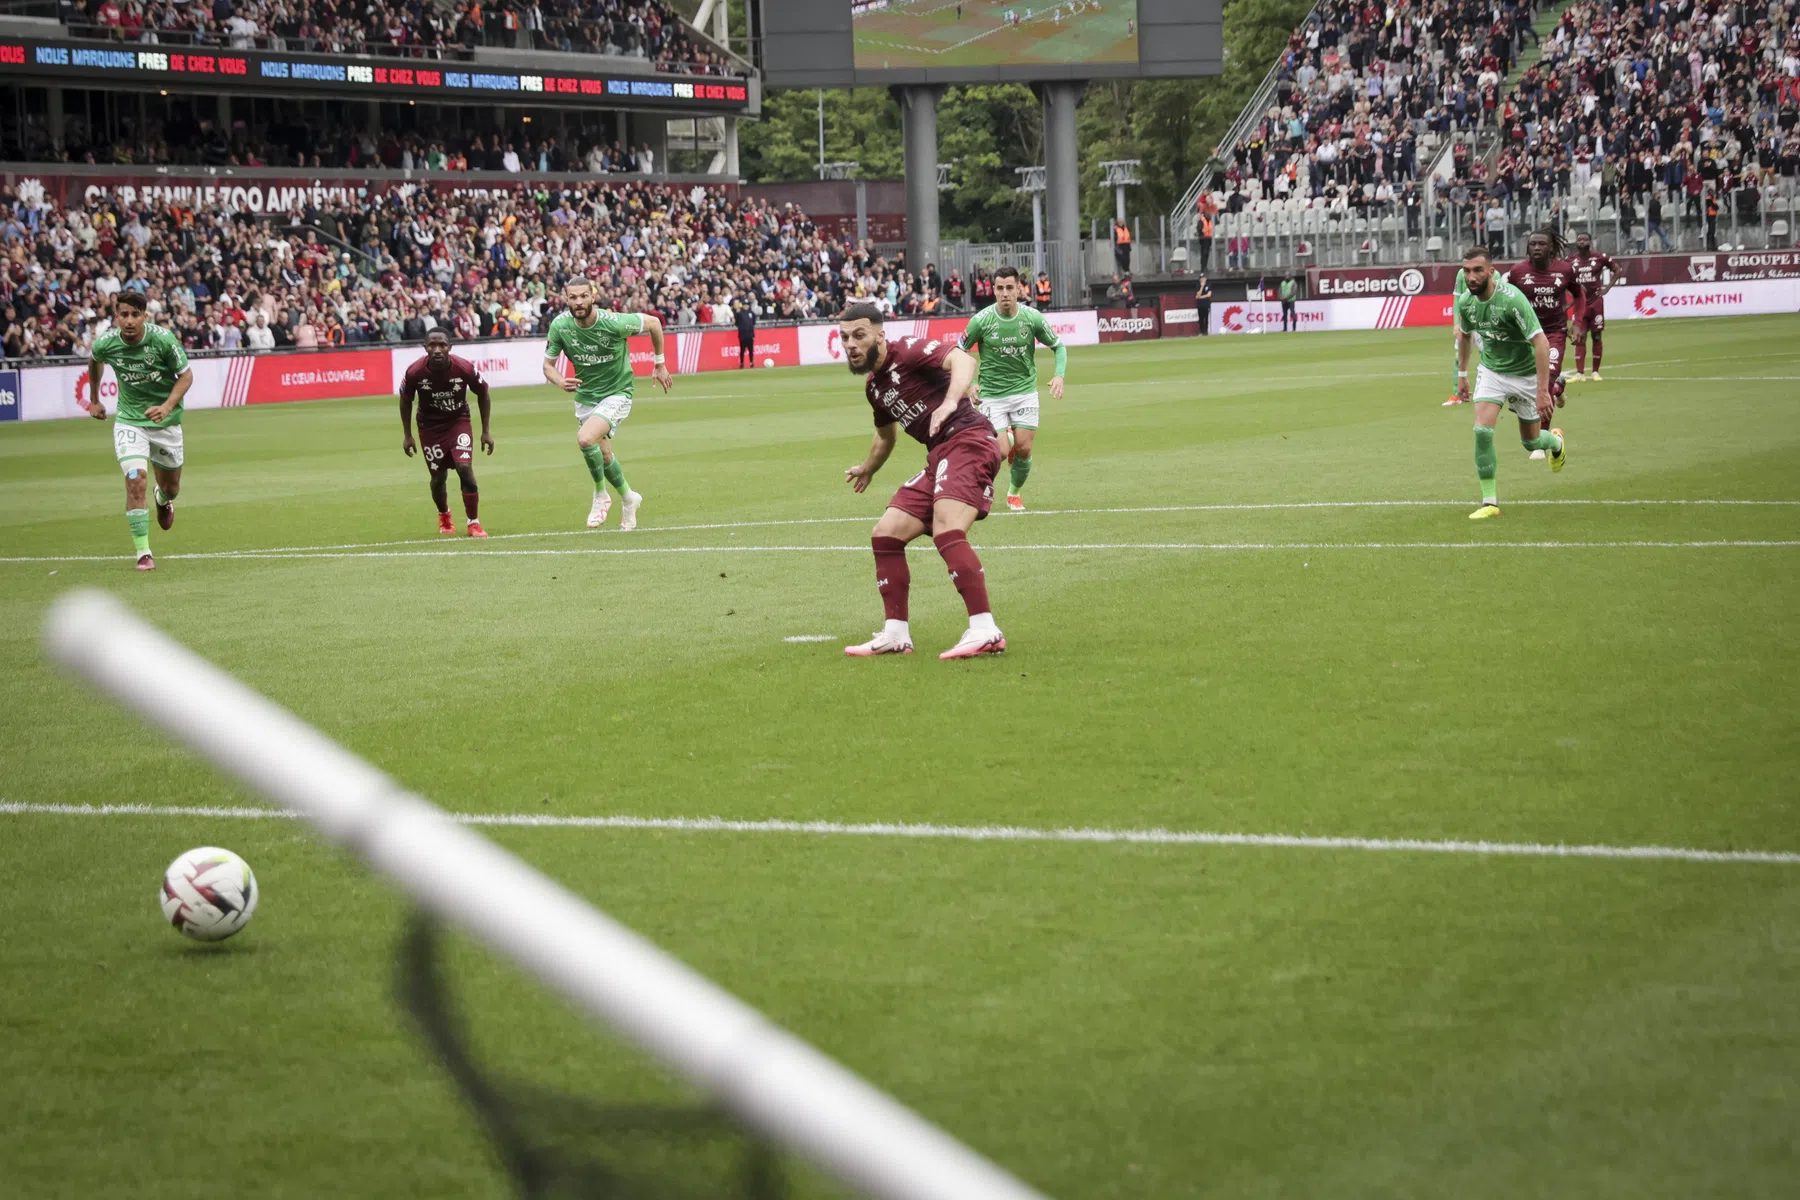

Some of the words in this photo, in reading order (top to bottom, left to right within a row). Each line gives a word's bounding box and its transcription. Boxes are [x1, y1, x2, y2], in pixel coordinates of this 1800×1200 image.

[0, 45, 26, 64] OUS
[35, 46, 69, 65] NOUS
[71, 48, 136, 69] MARQUONS
[170, 54, 185, 72] DE
[187, 55, 216, 73] CHEZ
[217, 57, 247, 75] VOUS
[261, 61, 289, 78] NOUS
[291, 63, 346, 81] MARQUONS
[374, 67, 388, 84] DE
[389, 68, 414, 85] CHEZ
[415, 70, 441, 86] VOUS
[445, 72, 470, 88] NOUS
[471, 73, 519, 91] MARQUONS
[544, 77, 556, 92] DE
[557, 78, 578, 93] CHEZ
[579, 79, 602, 95] VOUS
[607, 80, 630, 95] NOUS
[219, 186, 263, 212] ZOO
[1727, 253, 1790, 267] GROUPE
[1319, 277, 1398, 294] E.Leclerc
[1661, 293, 1743, 307] COSTANTINI
[1111, 317, 1153, 333] Kappa
[472, 359, 508, 373] TANTINI
[281, 373, 291, 386] LE
[890, 399, 909, 418] CAR
[117, 429, 137, 447] 29
[423, 443, 445, 462] 36
